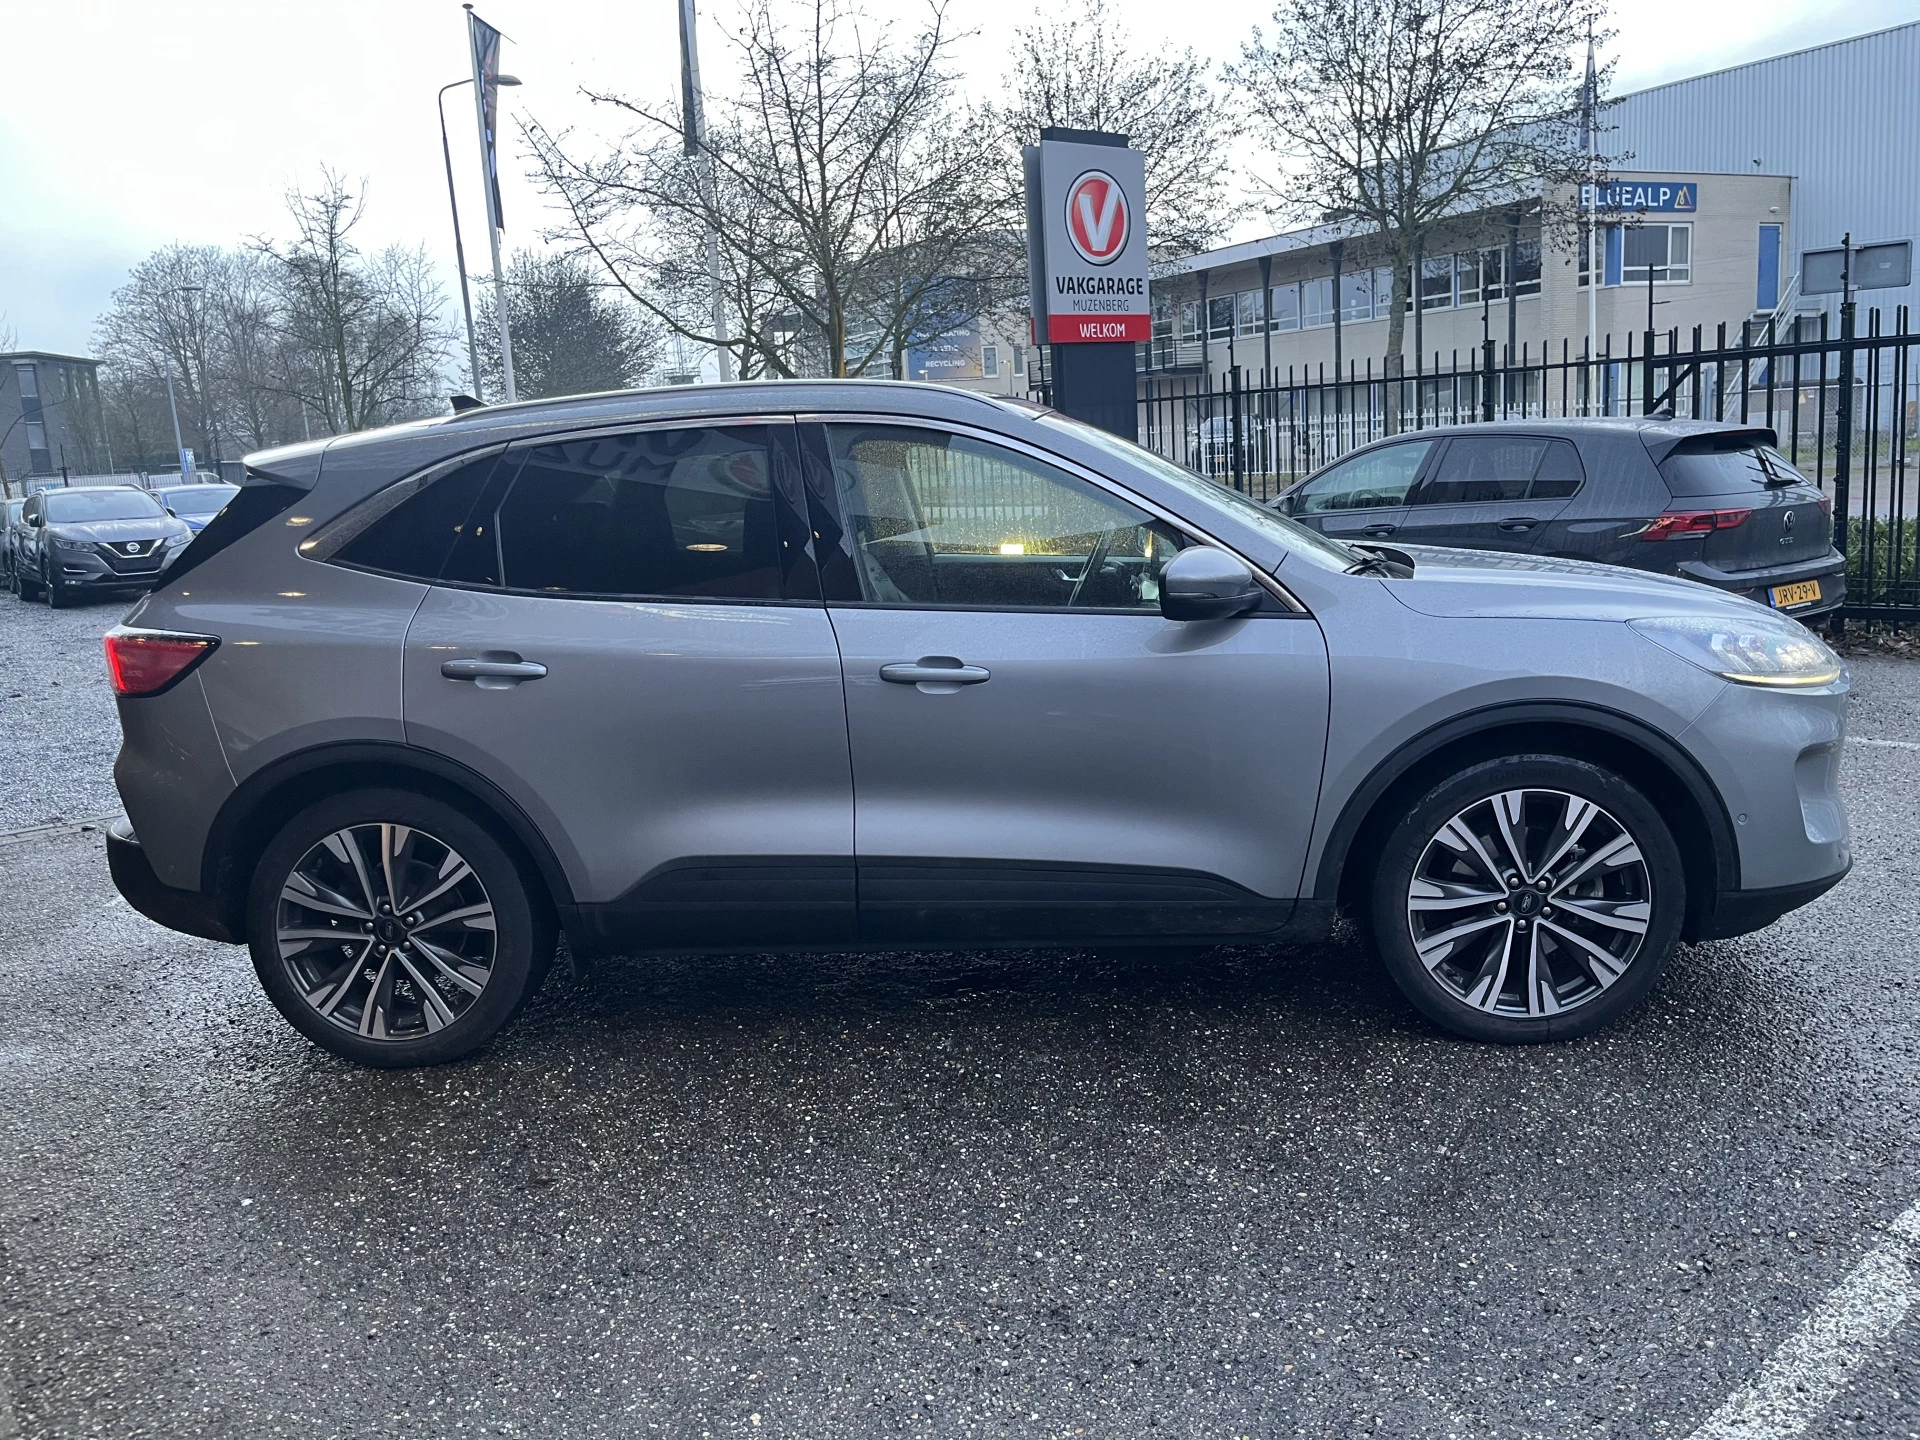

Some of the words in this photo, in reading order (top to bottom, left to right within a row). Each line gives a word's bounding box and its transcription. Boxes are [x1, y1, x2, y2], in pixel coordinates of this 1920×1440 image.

[1581, 186, 1671, 207] BLUEALP
[1056, 276, 1144, 296] VAKGARAGE
[1073, 299, 1129, 312] MUZENBERG
[1079, 323, 1126, 338] WELKOM
[925, 359, 966, 369] RECYCLING
[1778, 582, 1816, 606] JRV-29-V
